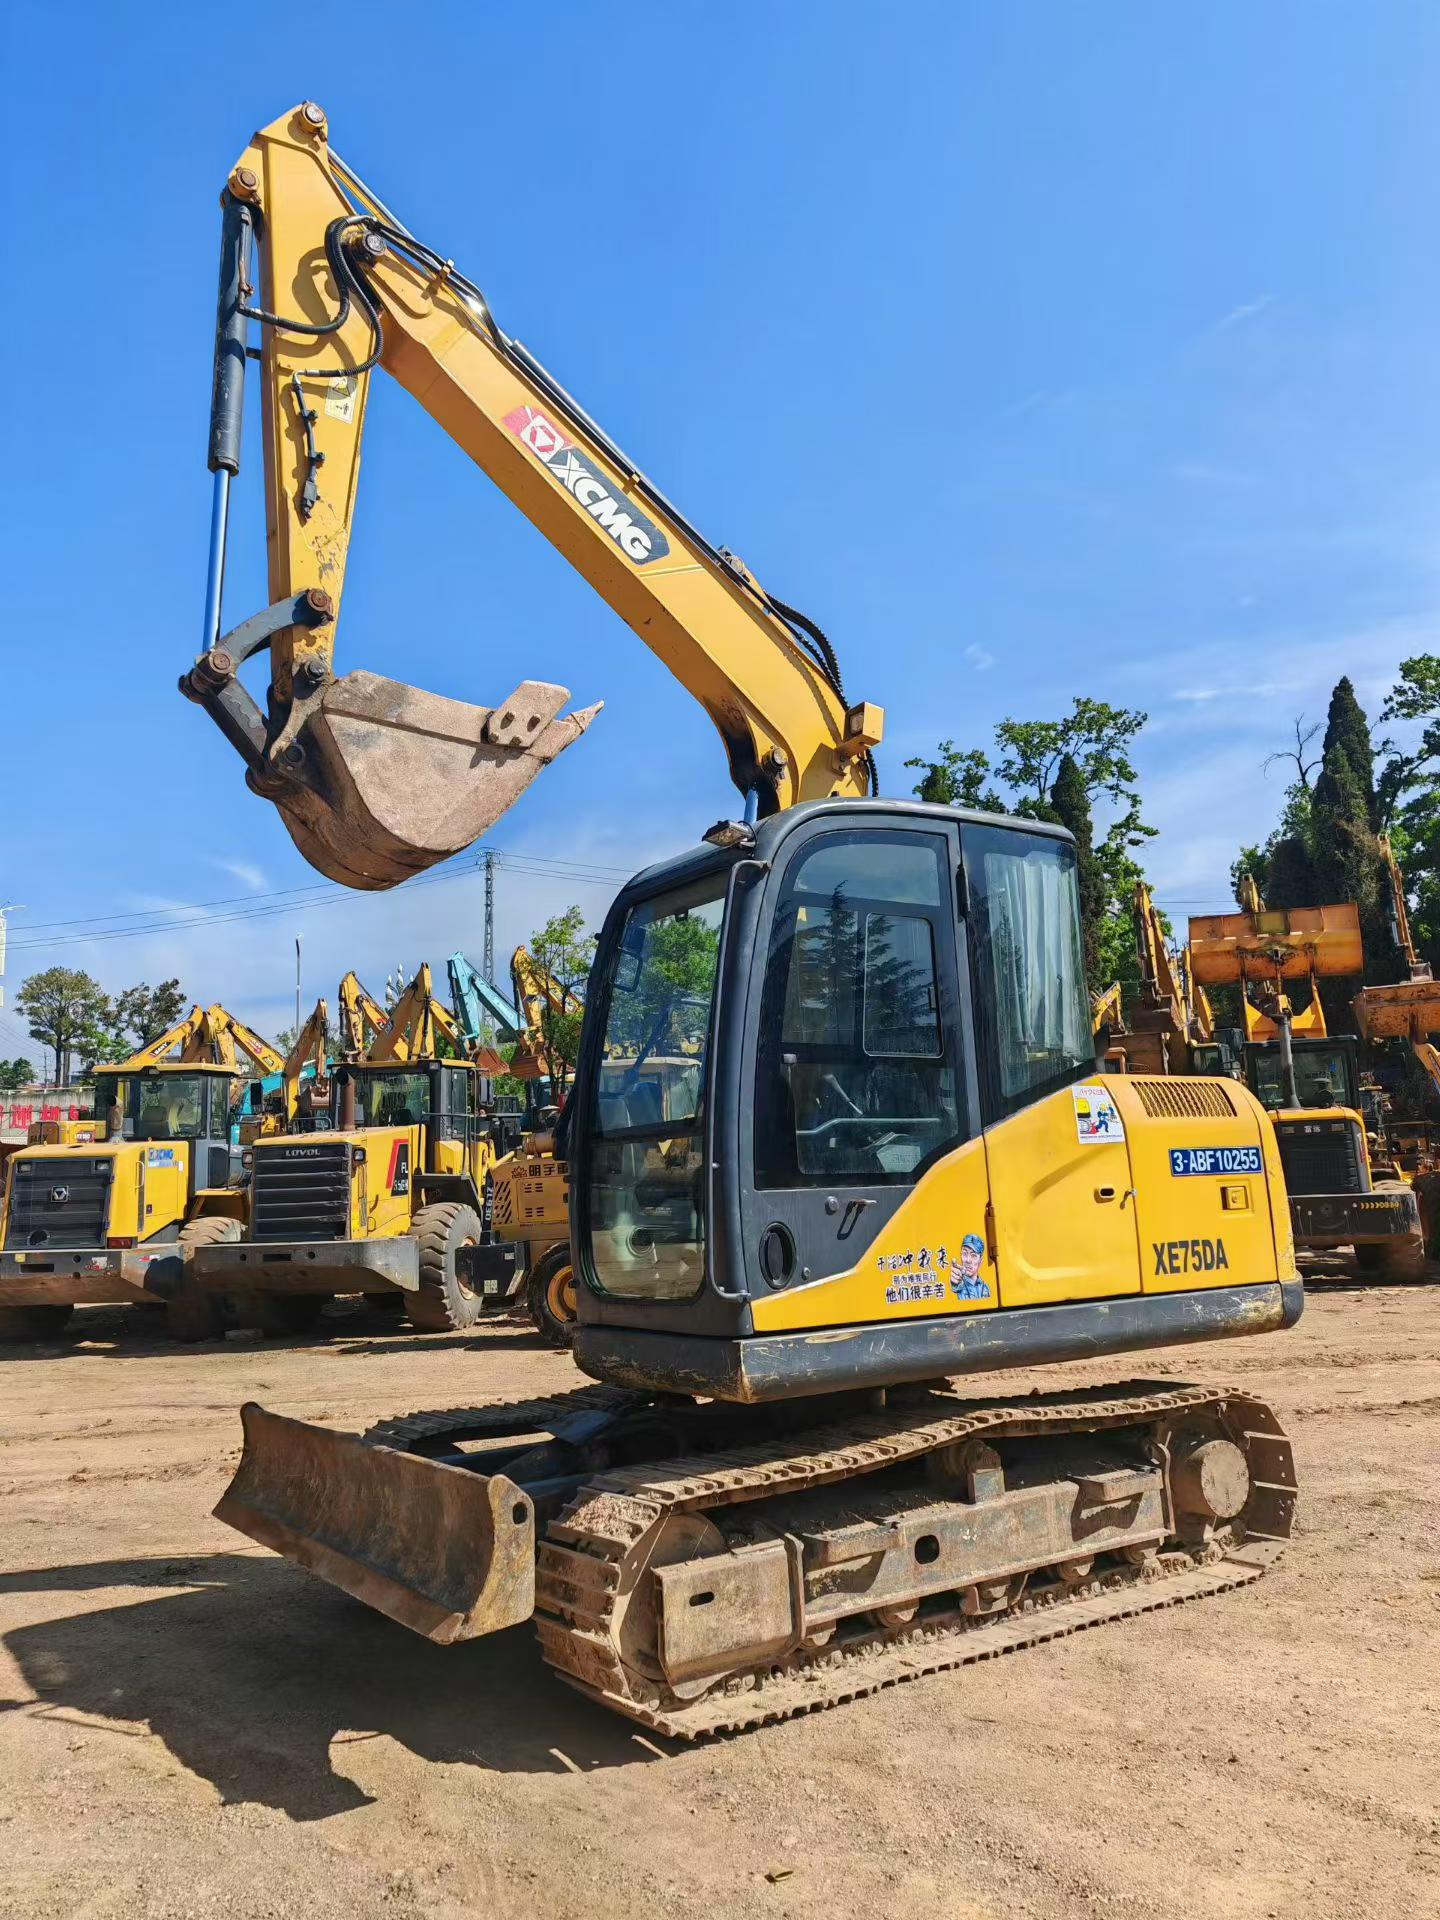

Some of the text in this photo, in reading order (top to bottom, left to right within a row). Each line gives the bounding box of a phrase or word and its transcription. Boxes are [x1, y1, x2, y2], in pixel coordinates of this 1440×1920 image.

[547, 447, 653, 561] XCMG
[285, 1148, 321, 1157] LOVOL
[401, 1162, 409, 1174] FL
[877, 1247, 949, 1272] 干活冲我来
[1152, 1238, 1229, 1276] XE75DA
[885, 1283, 945, 1303] 他们很辛苦
